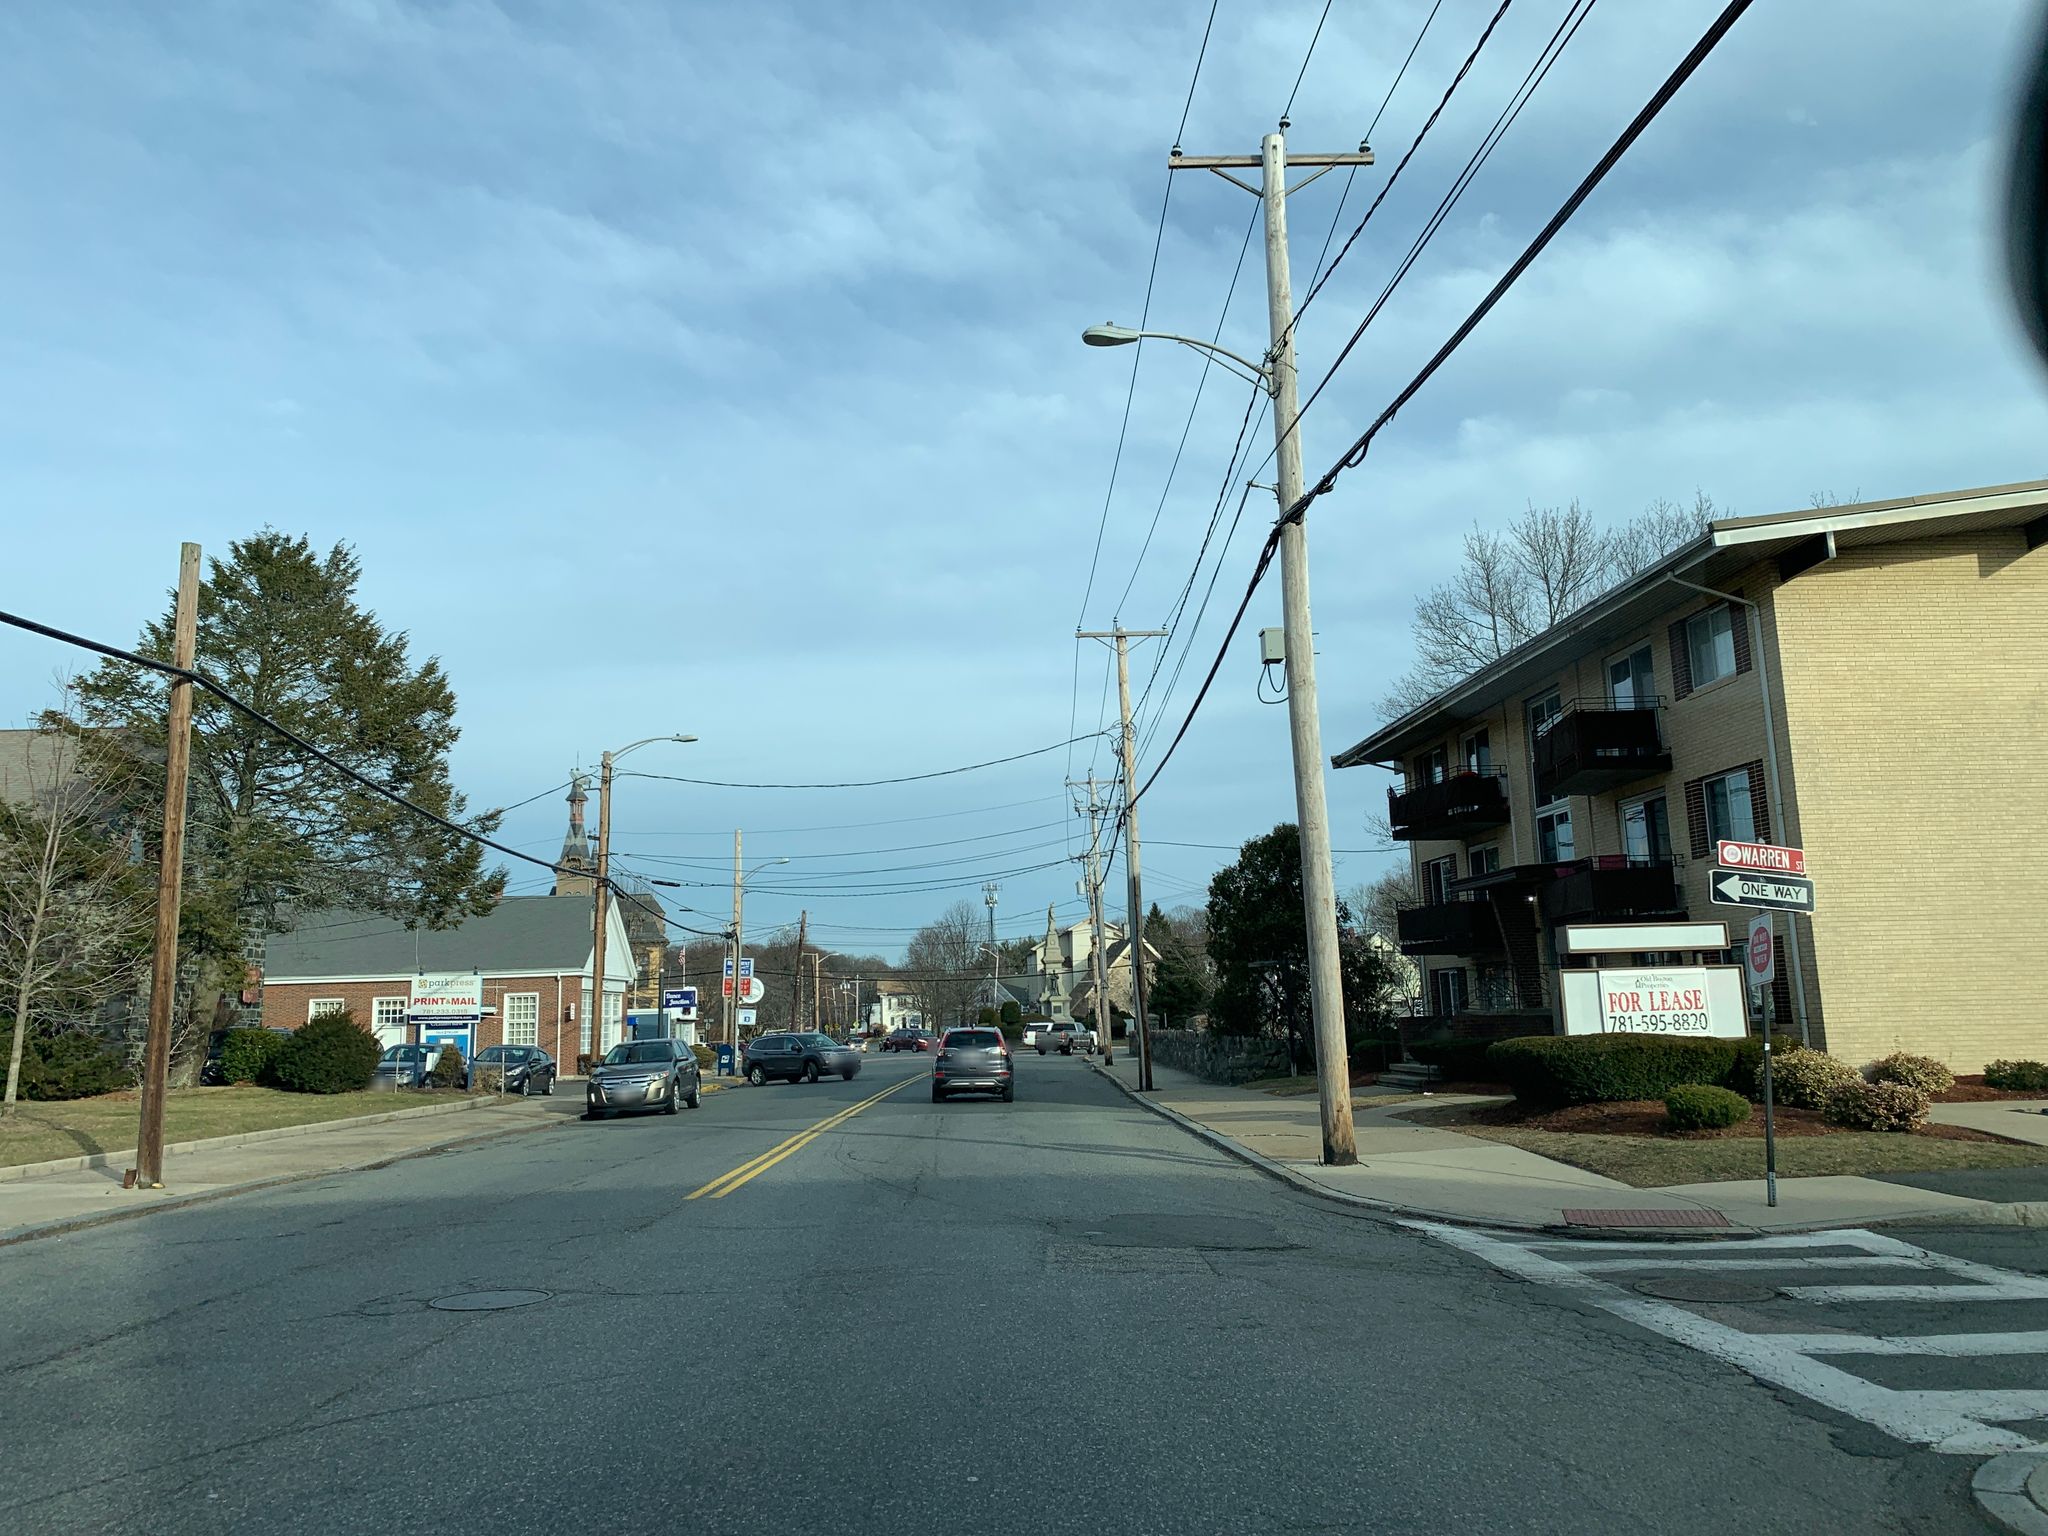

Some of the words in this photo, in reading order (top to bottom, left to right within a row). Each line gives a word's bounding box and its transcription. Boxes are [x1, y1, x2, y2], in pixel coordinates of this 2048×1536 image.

[1741, 845, 1790, 868] WARREN
[1795, 861, 1804, 870] ST
[1741, 882, 1768, 897] ONE
[1774, 885, 1802, 900] WAY
[428, 978, 474, 988] parkpress
[1608, 991, 1644, 1013] FOR
[1648, 989, 1704, 1011] LEASE
[1609, 1012, 1708, 1033] 781-595-8820
